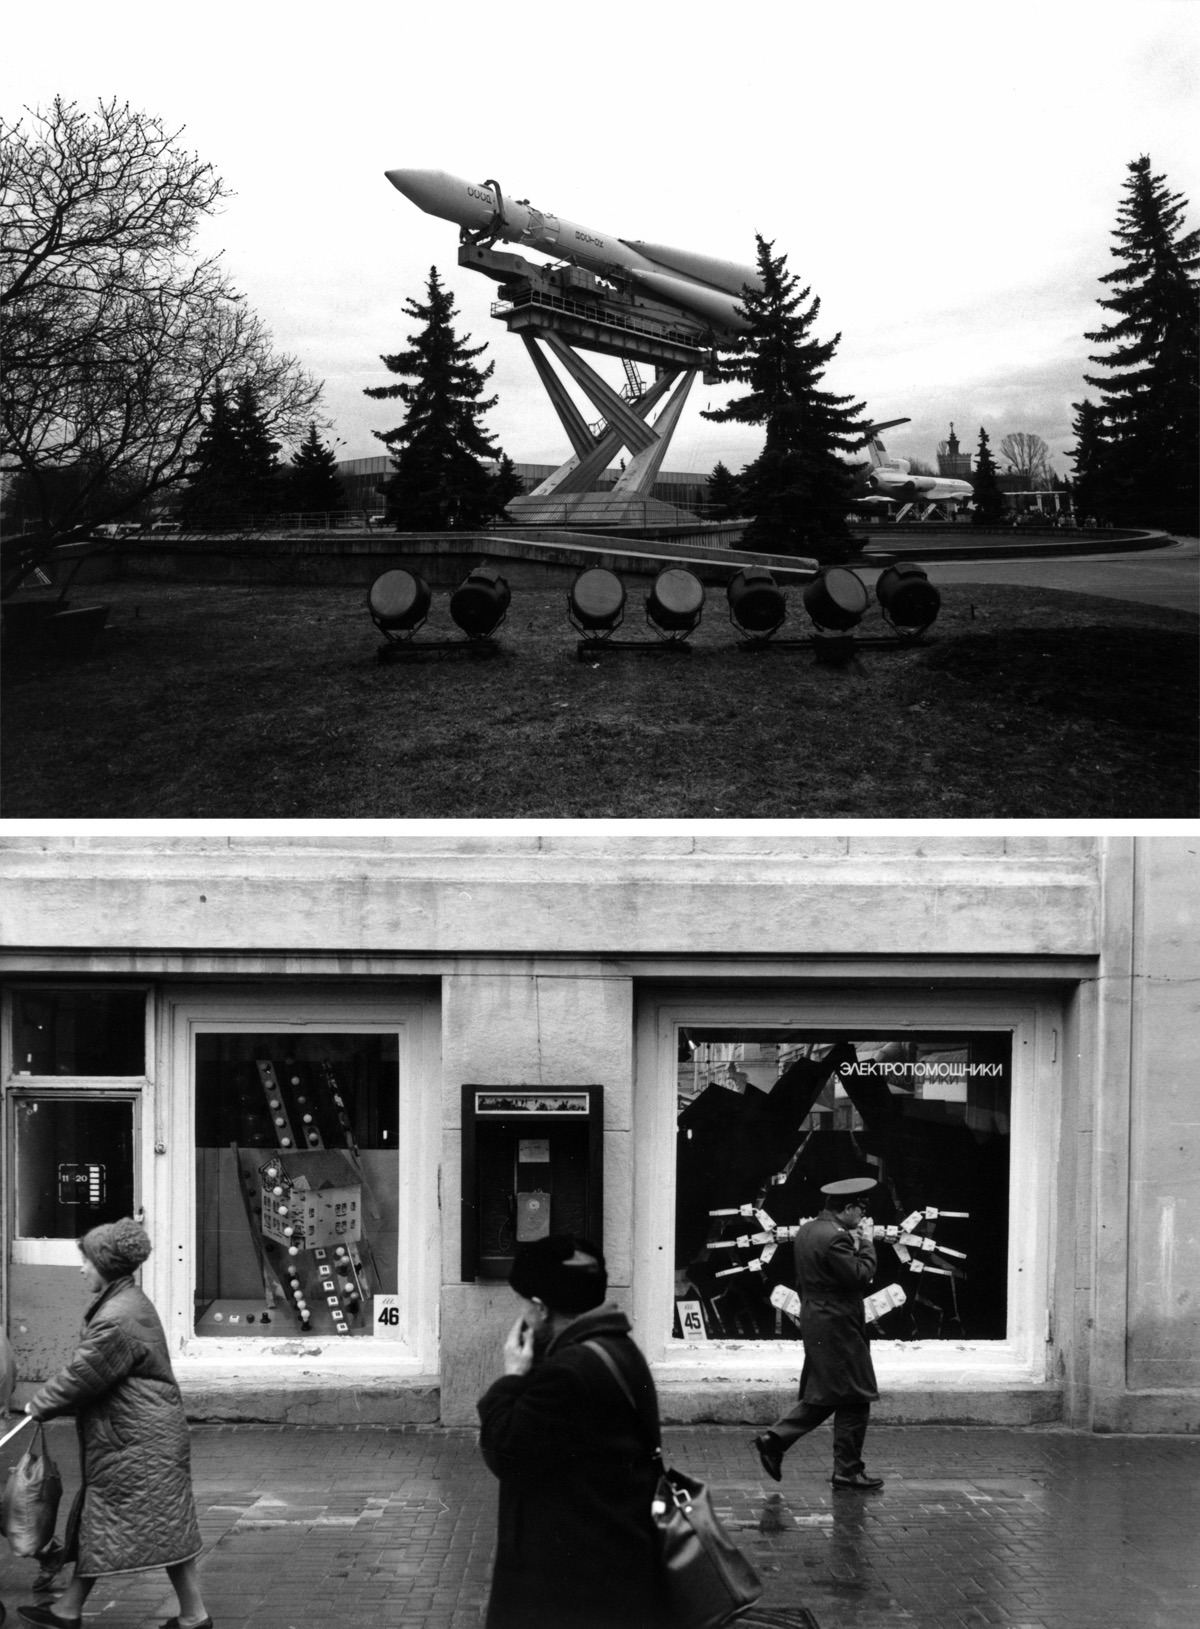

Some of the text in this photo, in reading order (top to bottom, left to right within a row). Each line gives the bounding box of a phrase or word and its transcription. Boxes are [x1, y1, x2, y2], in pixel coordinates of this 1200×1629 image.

[467, 187, 493, 204] СССР
[575, 231, 604, 248] ВОСТОК
[840, 1062, 1002, 1077] ЭЛЕКТРОПОМОЩНИКИ
[378, 1307, 399, 1326] 46
[685, 1312, 701, 1330] 45
